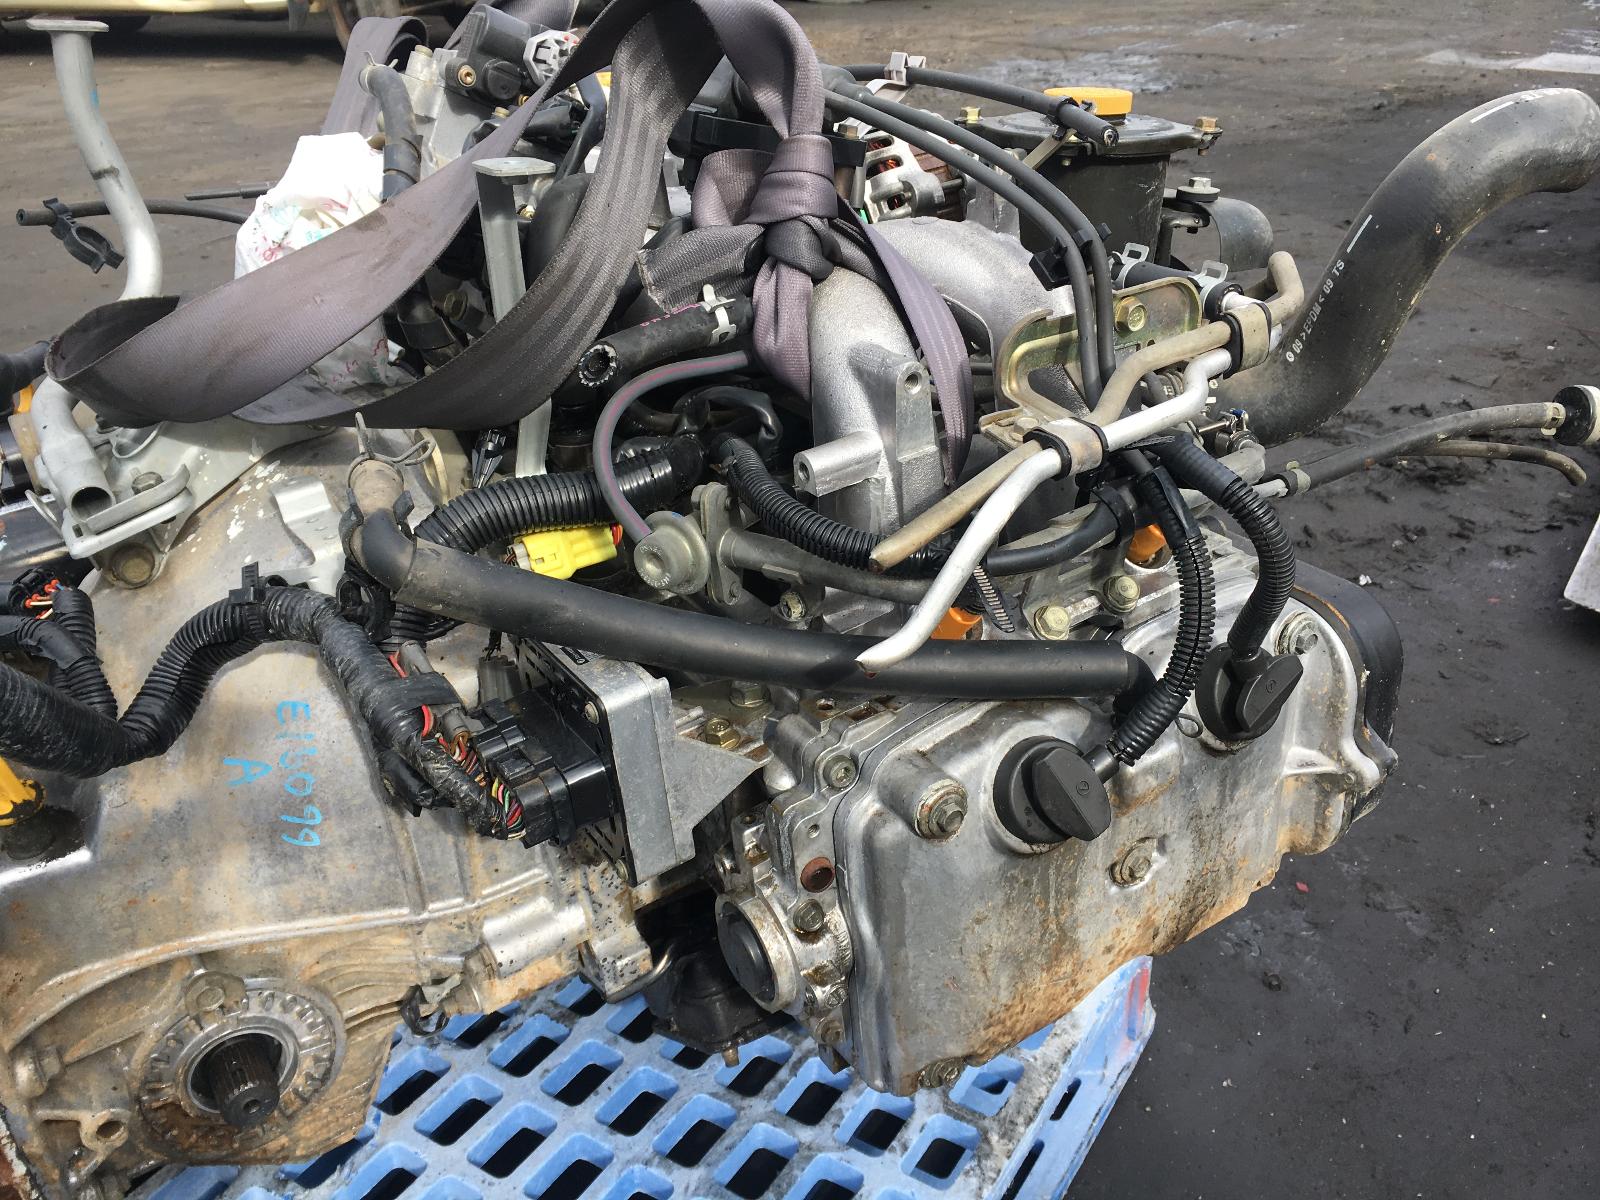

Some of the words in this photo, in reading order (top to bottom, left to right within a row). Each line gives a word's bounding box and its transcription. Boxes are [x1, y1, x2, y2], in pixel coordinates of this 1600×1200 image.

[1292, 338, 1304, 354] 09
[1322, 278, 1334, 294] 09
[1331, 259, 1345, 277] TS
[223, 757, 273, 787] A
